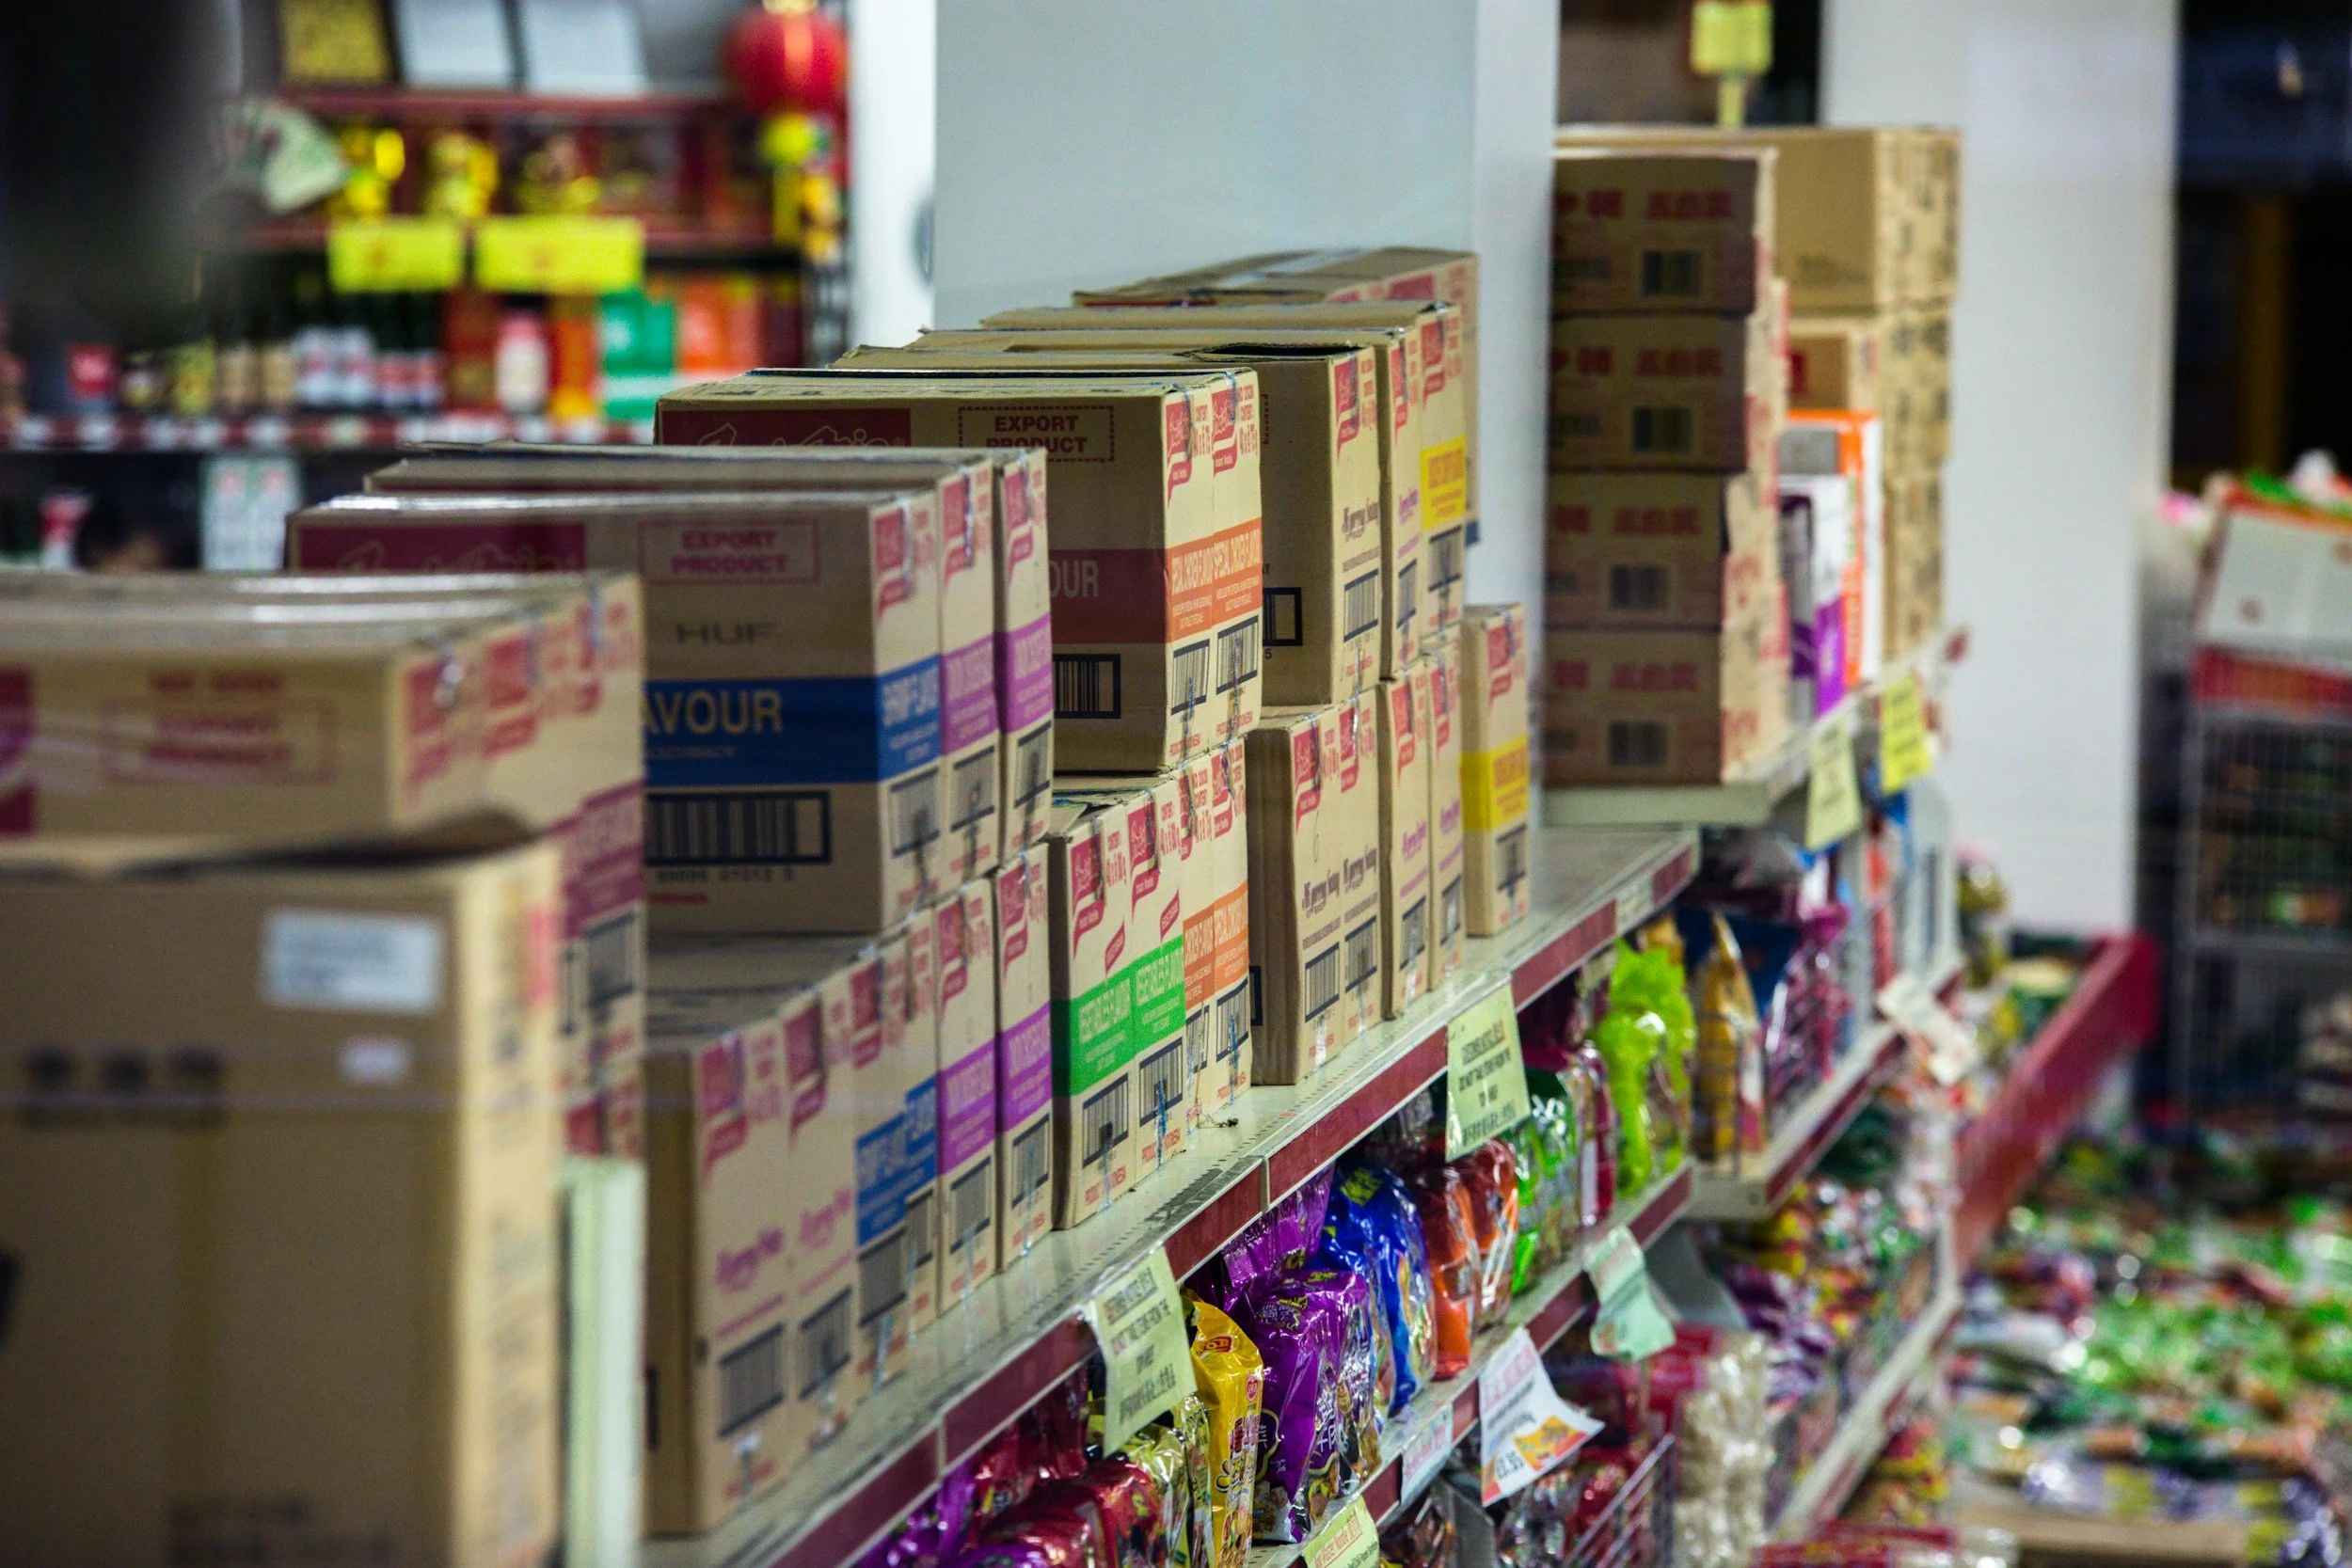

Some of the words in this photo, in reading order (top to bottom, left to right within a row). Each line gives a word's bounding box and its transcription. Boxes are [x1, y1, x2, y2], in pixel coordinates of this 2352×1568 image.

[994, 415, 1079, 432] EXPORT
[682, 530, 776, 549] EXPORT
[672, 553, 787, 575] PRODUCT
[1264, 648, 1272, 659] 5
